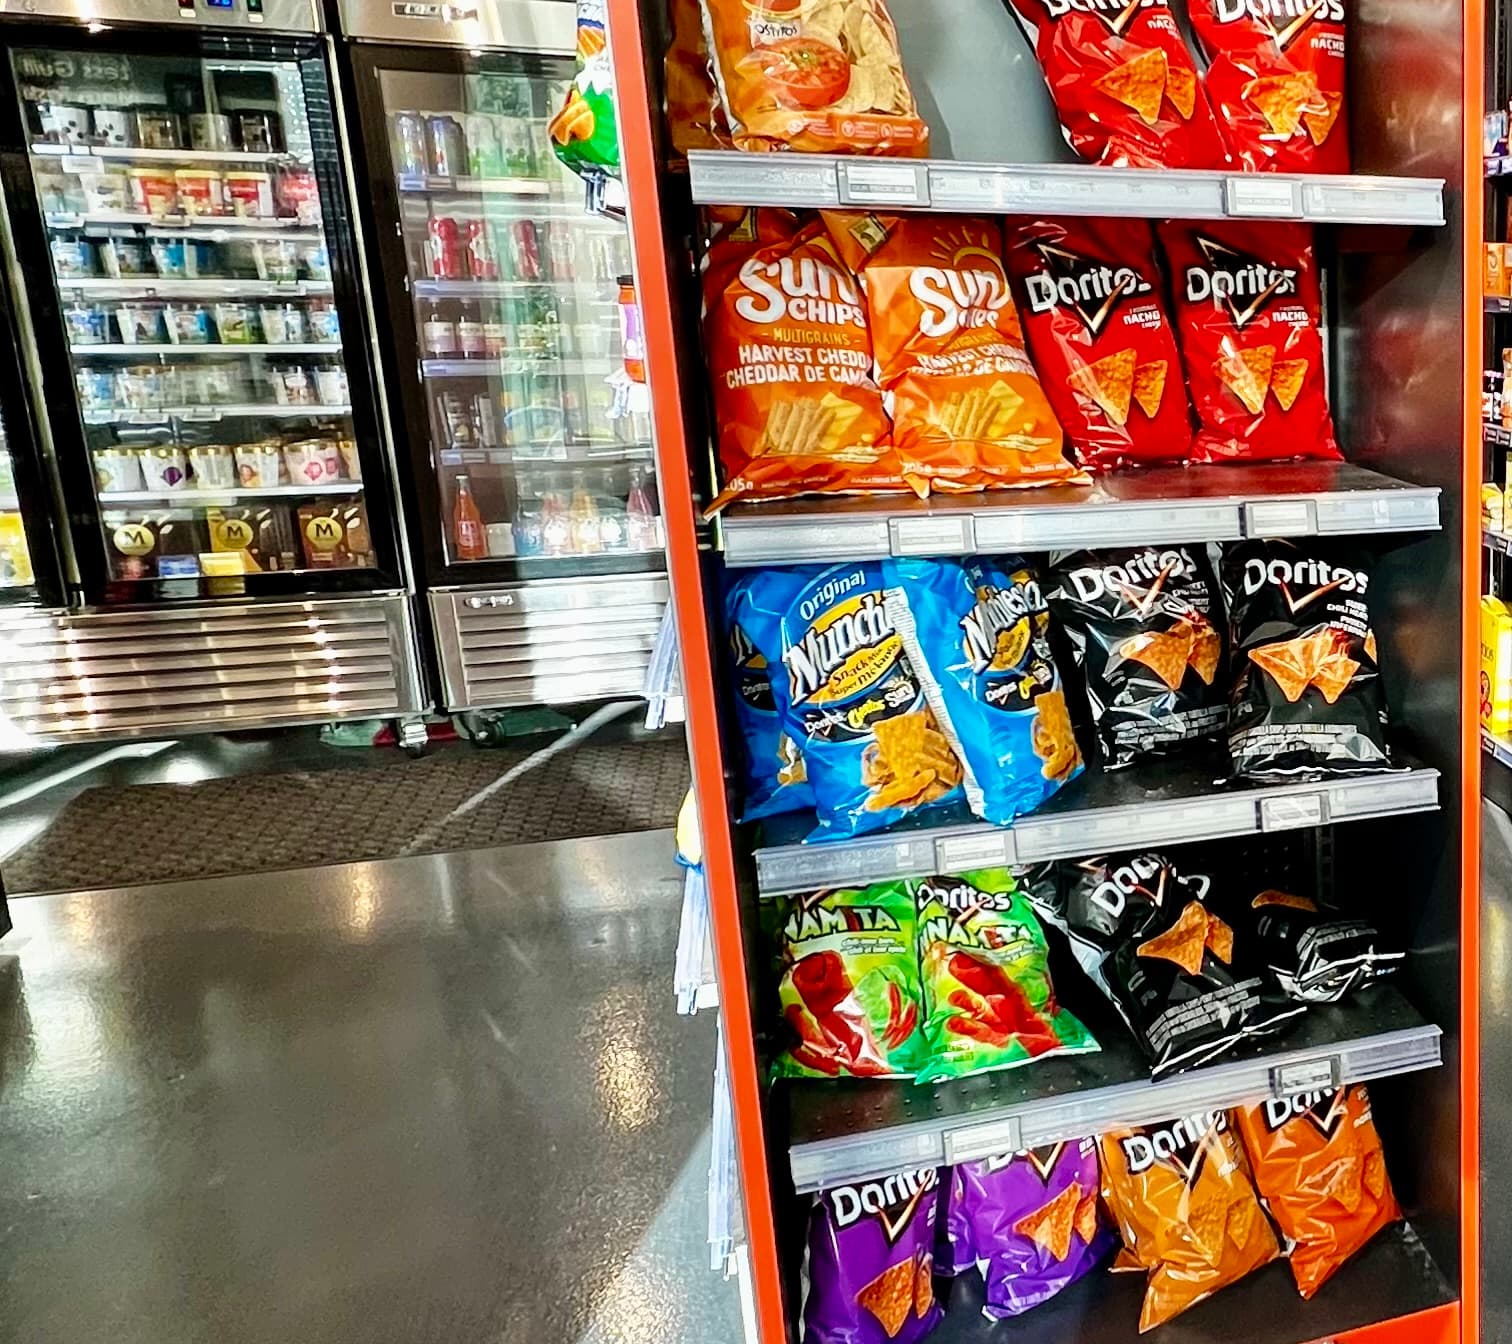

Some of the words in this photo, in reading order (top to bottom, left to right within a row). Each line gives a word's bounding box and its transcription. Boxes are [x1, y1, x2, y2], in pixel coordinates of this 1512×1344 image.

[735, 256, 858, 324] Sun
[1186, 264, 1297, 303] Doritos
[786, 299, 867, 329] CHIPS
[909, 266, 1011, 338] Sun
[1123, 311, 1161, 325] NACHO
[1272, 311, 1309, 323] NACHO
[773, 327, 851, 346] MULTIGRAINS
[738, 344, 813, 365] HARVEST
[726, 364, 802, 389] CHEDDAR
[804, 365, 827, 383] DE
[225, 526, 245, 539] M
[315, 522, 335, 538] M
[1069, 547, 1198, 604] Doritos
[1244, 558, 1369, 596] Doritos
[800, 569, 866, 621] Original
[832, 658, 868, 685] Snack
[917, 883, 1011, 912] Doritos
[829, 1165, 940, 1228] Dorito
